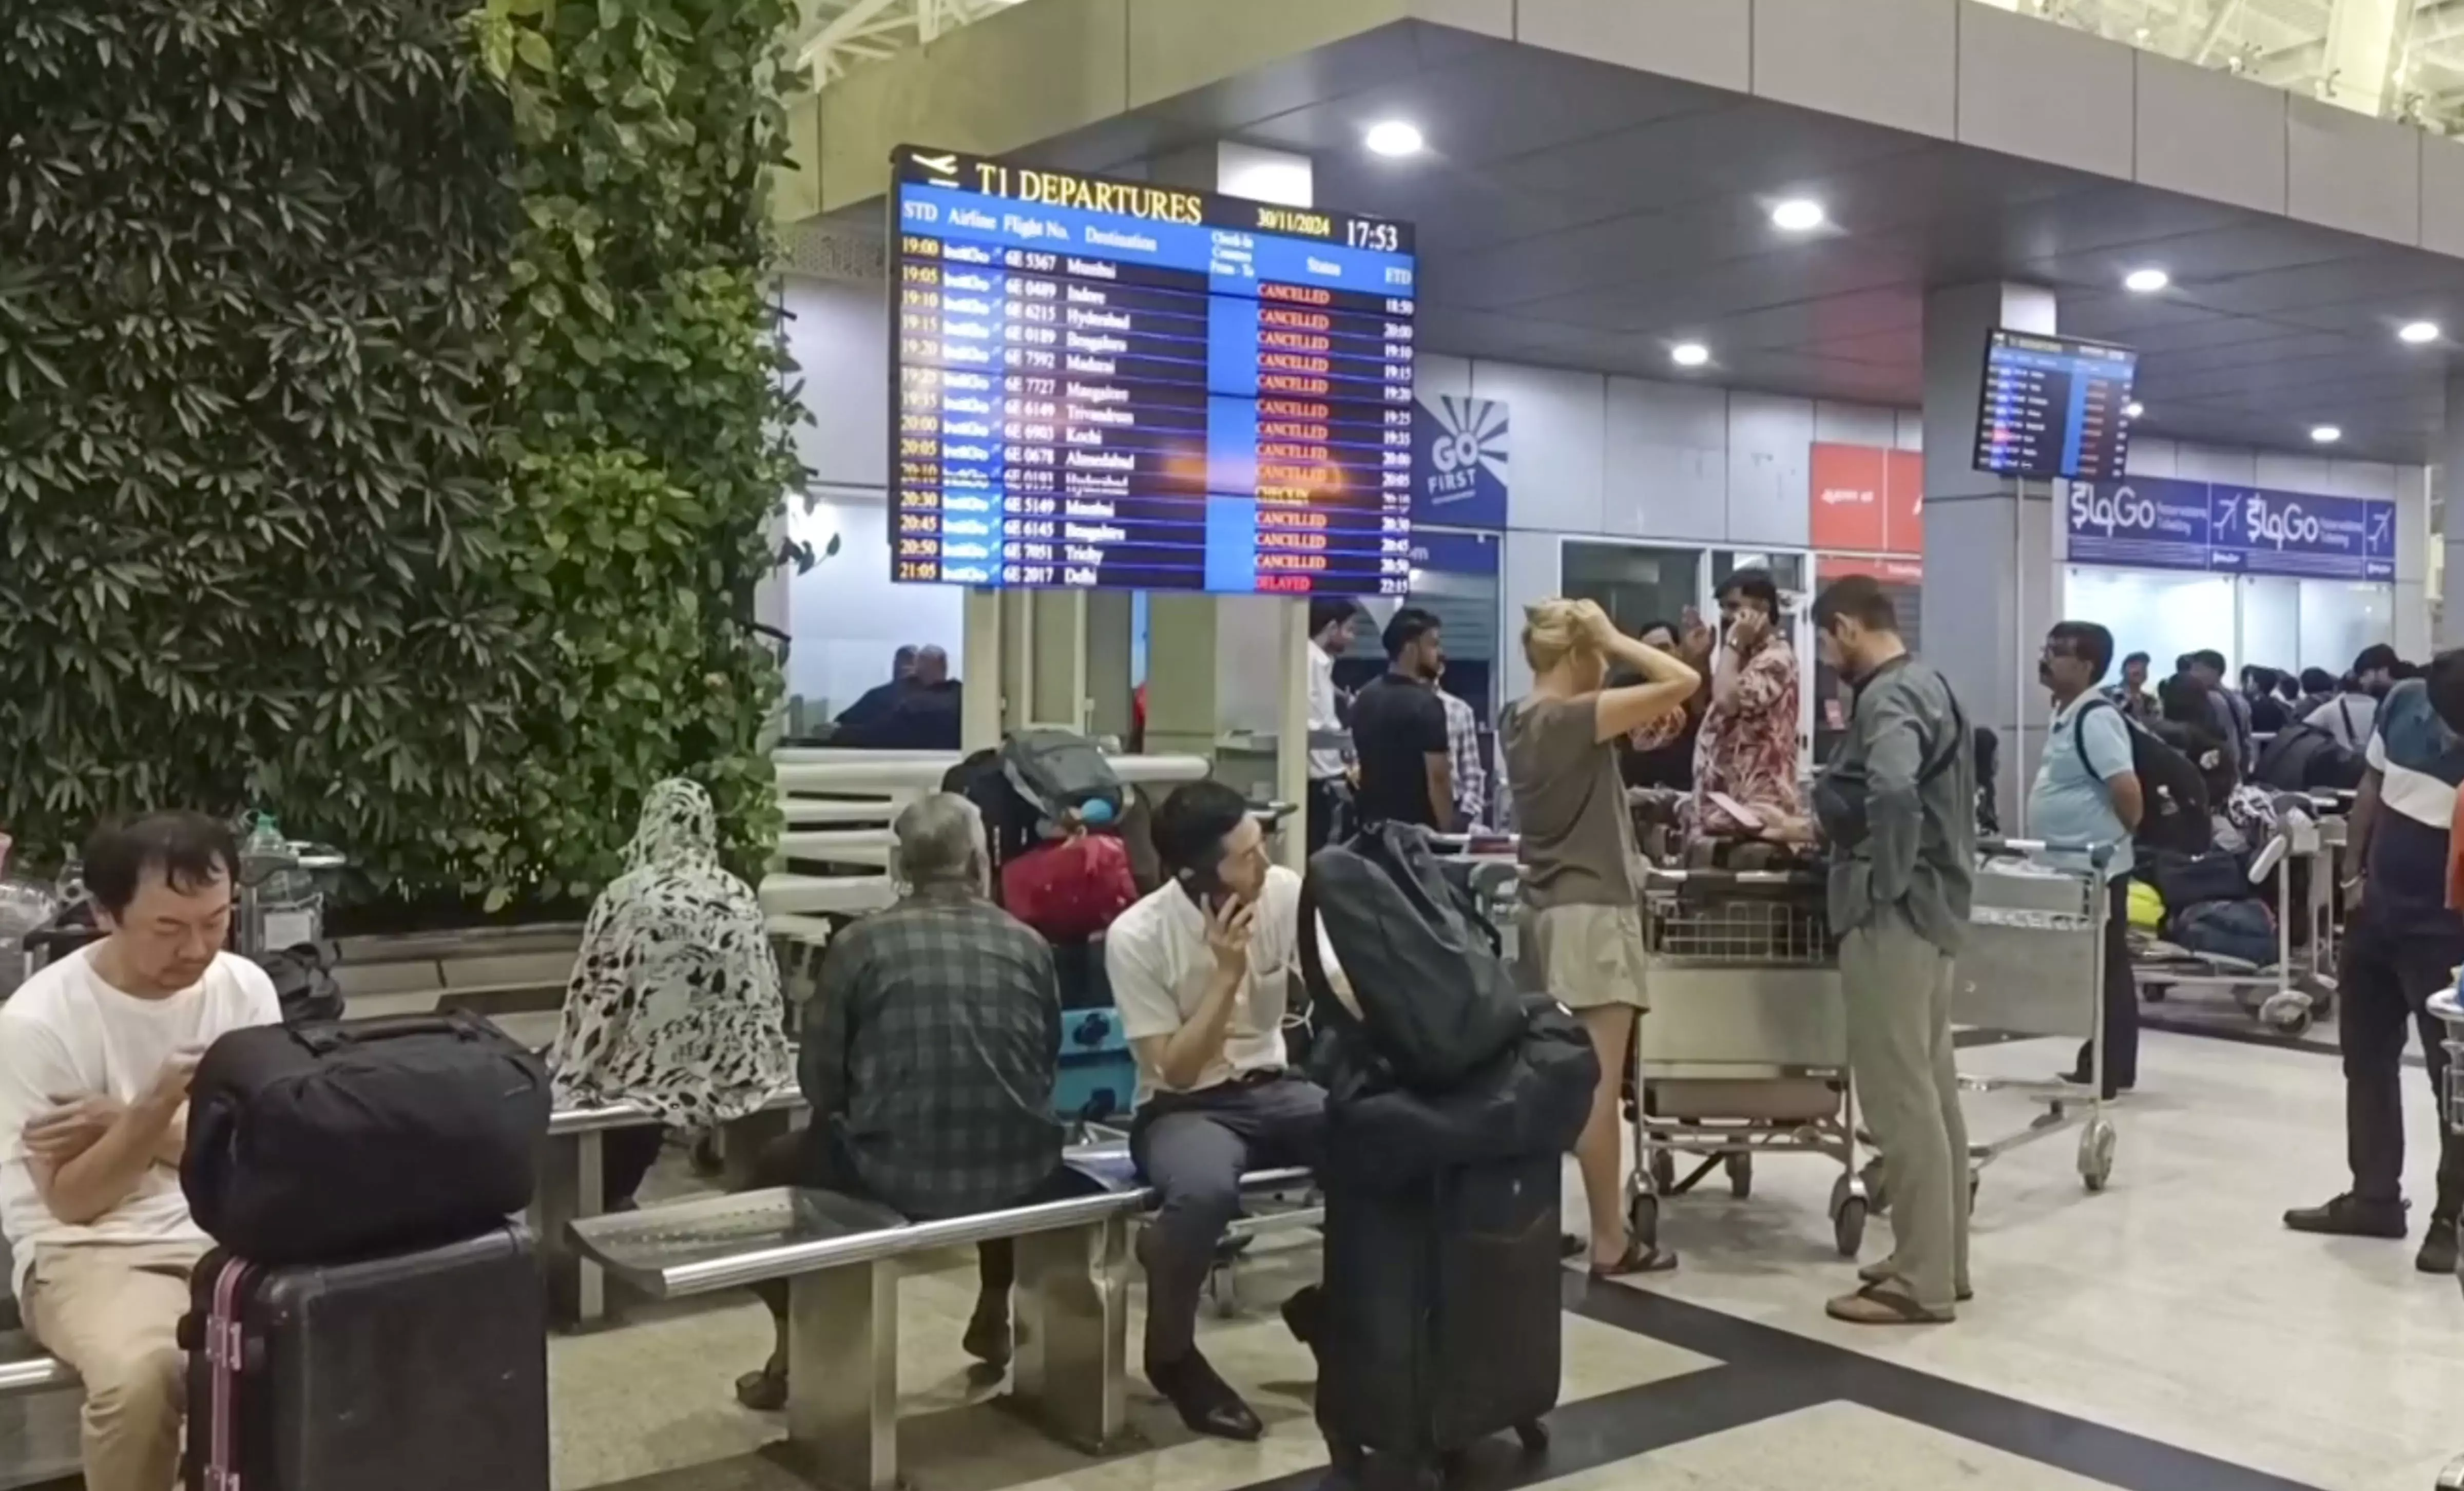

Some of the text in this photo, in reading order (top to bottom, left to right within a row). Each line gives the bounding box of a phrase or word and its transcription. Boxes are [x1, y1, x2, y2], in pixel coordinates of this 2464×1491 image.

[976, 163, 1202, 225] T1 DEPARTURES
[903, 201, 938, 222] STD
[948, 206, 997, 230] Airline
[1004, 213, 1043, 239] Flight
[1085, 225, 1157, 252] Destination
[1257, 207, 1331, 236] 30/11/2024
[1346, 219, 1398, 251] 17:53
[903, 237, 938, 256] 19:00
[1067, 257, 1115, 278] Mumbai
[1257, 283, 1330, 304] CANCELLED
[903, 265, 938, 284] 19:05
[1257, 308, 1330, 330] CANCELLED
[1257, 331, 1329, 351] CANCELLED
[1257, 353, 1329, 372] CANCELLED
[1256, 374, 1329, 392] CANCELLED
[1256, 398, 1329, 417] CANCELLED
[1066, 426, 1102, 444] Kochi
[1255, 443, 1327, 460] CANCELLED
[1256, 422, 1328, 438] CANCELLED
[1432, 433, 1477, 472] GO
[1255, 464, 1327, 482] CANCELLED
[1428, 467, 1477, 495] FIRST
[1066, 499, 1114, 517] Mumbai
[1255, 511, 1327, 528] CANCELLED
[1254, 532, 1326, 549] CANCELLED
[1254, 553, 1326, 570] CANCELLED
[899, 562, 936, 580] 21:05
[1064, 567, 1097, 585] Delhi
[1256, 576, 1311, 591] DELAYED
